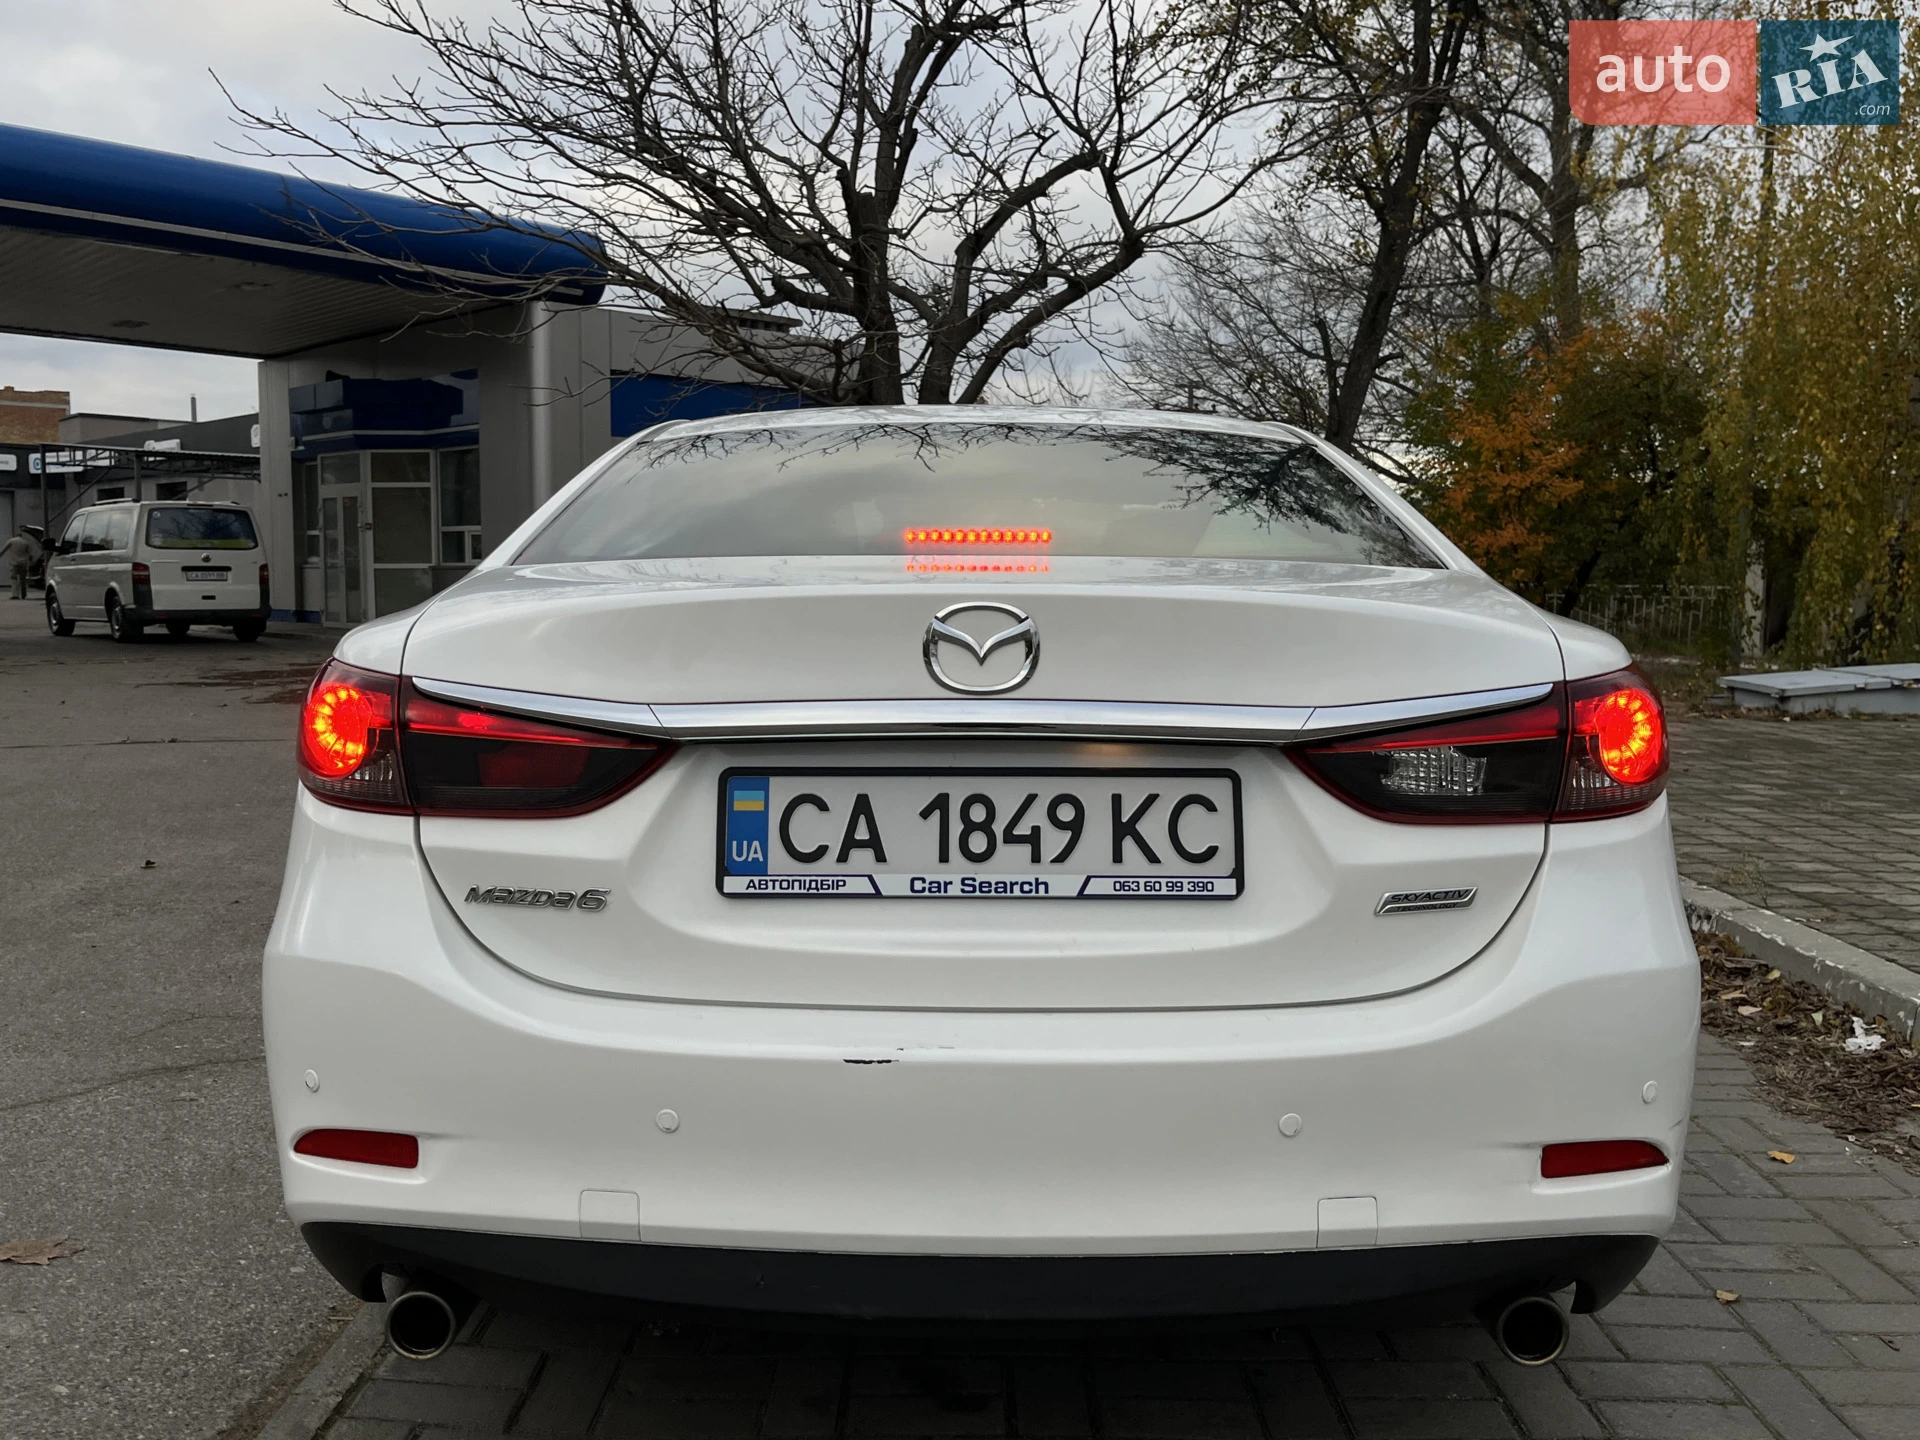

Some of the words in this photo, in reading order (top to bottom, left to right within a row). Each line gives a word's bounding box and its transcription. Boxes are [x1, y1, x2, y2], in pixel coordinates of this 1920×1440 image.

[778, 792, 888, 864] CA
[918, 792, 1087, 864] 1849
[1111, 792, 1220, 864] KC
[731, 839, 765, 863] UA
[744, 877, 847, 893] АВТОПІДБІР
[909, 876, 956, 896] Car
[959, 876, 1050, 896] Search
[1112, 879, 1142, 894] 063
[1143, 879, 1163, 894] 60
[1164, 879, 1185, 894] 99
[1186, 879, 1214, 894] 390
[1390, 889, 1470, 903] SKYACTIV
[1396, 903, 1458, 912] TECHNOLOGY
